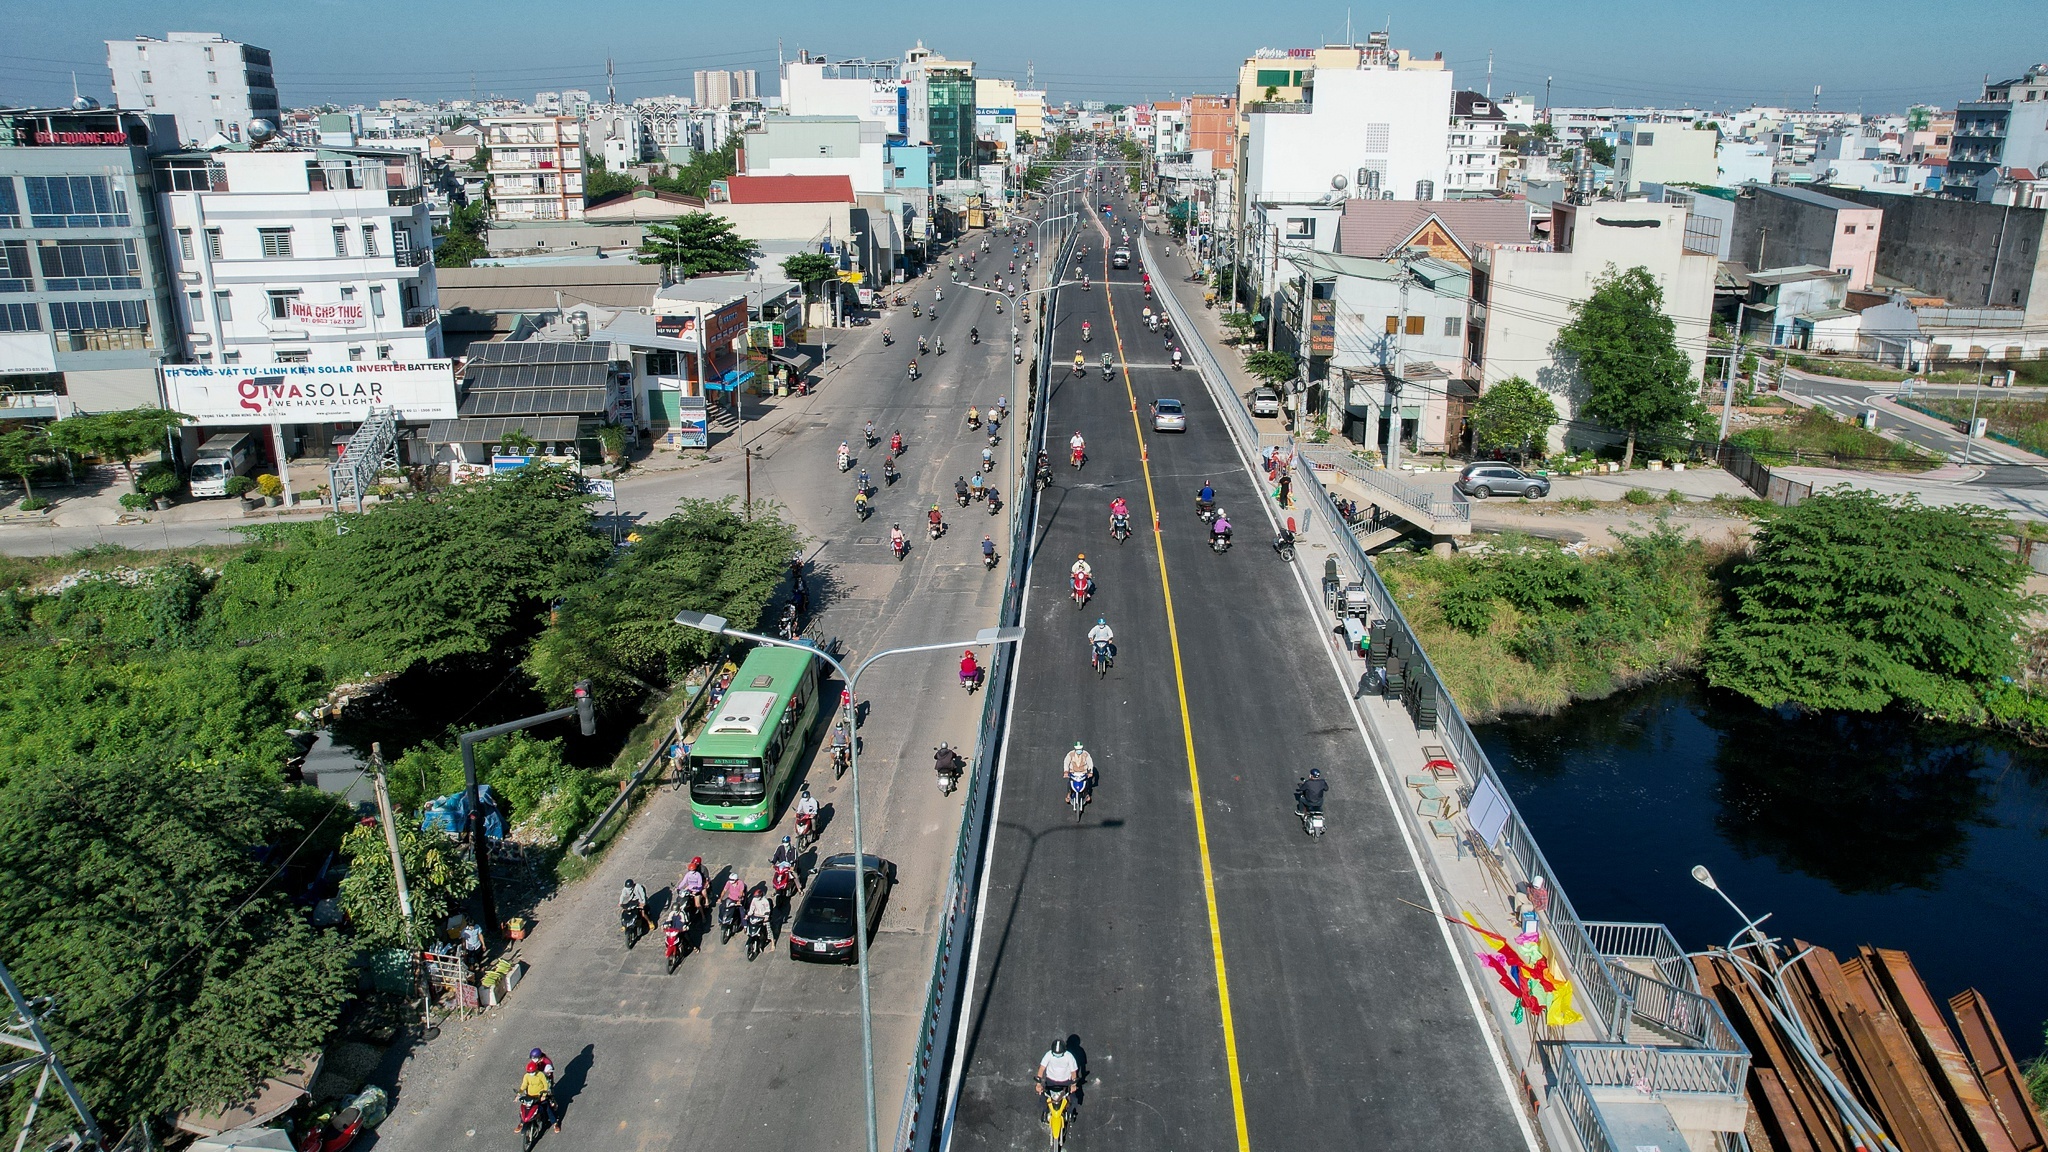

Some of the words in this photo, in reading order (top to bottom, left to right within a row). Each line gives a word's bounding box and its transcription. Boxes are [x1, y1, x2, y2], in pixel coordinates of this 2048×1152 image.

[1288, 49, 1315, 57] HOTEL
[61, 132, 101, 145] QUANG
[292, 303, 313, 317] NHÀ
[315, 306, 335, 318] CHO
[318, 365, 353, 374] SOLAR
[356, 364, 407, 373] INVERTER
[407, 363, 451, 371] BATTERY
